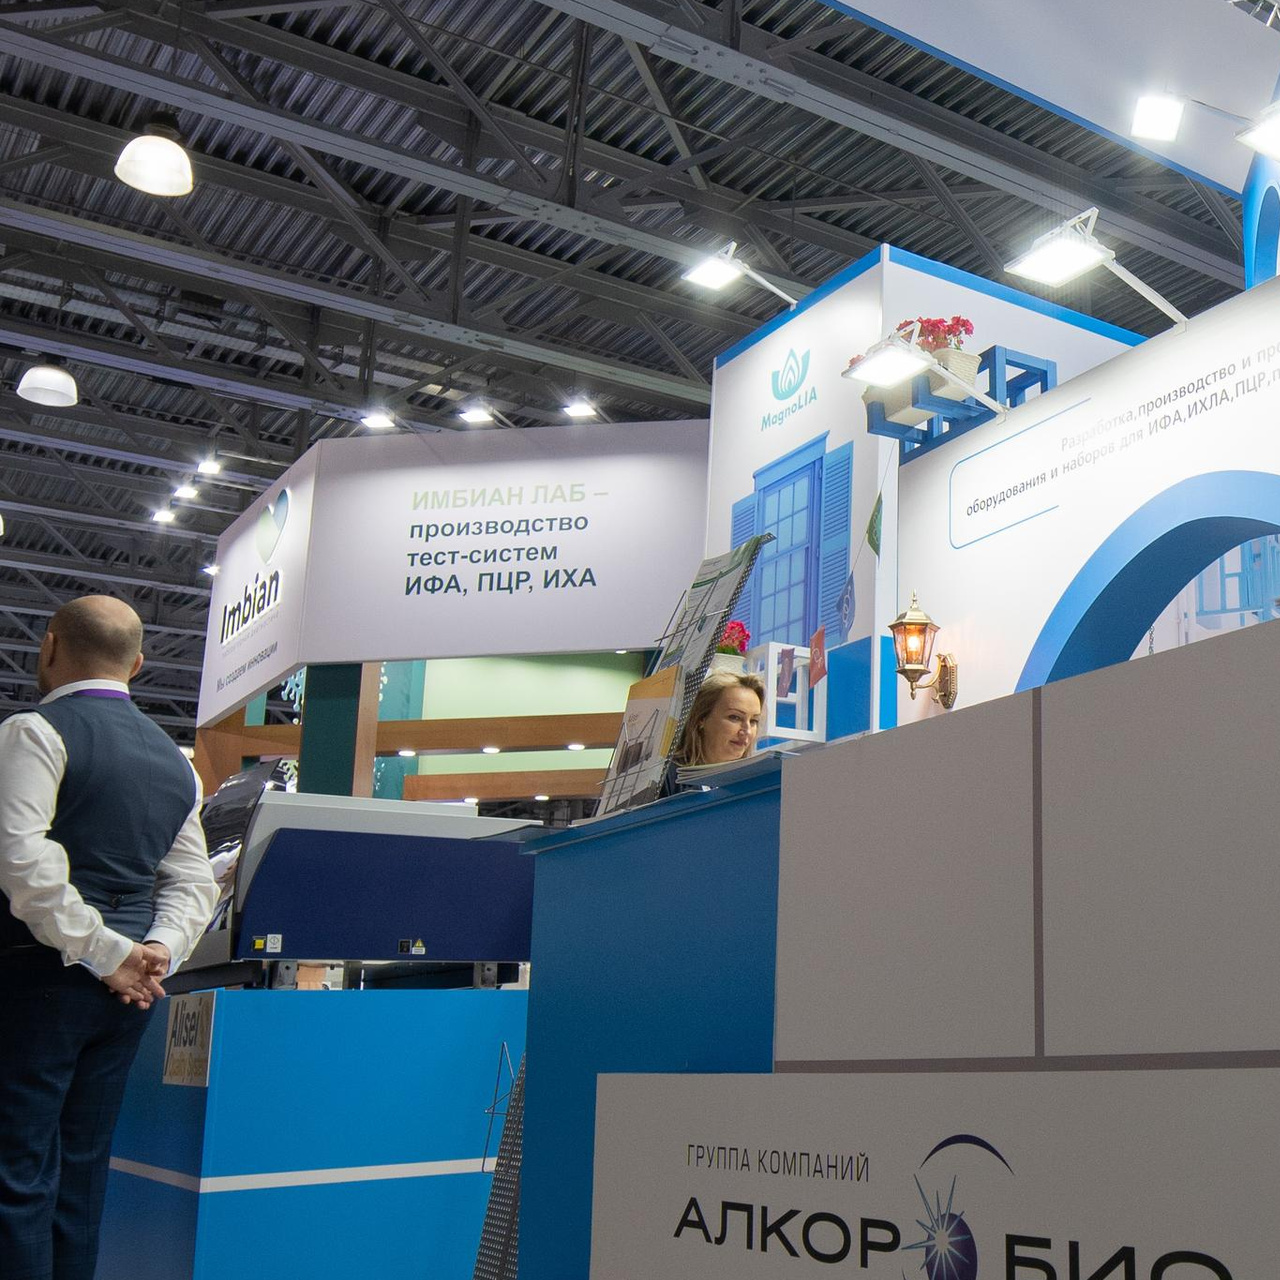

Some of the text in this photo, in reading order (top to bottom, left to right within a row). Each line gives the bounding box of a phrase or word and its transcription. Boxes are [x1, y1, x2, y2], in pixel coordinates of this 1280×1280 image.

[1241, 356, 1252, 370] и
[965, 472, 1047, 518] оборудования
[1050, 467, 1059, 480] и
[1061, 443, 1116, 476] наборов
[1118, 429, 1145, 453] для
[411, 485, 525, 511] ИМБИАН
[530, 482, 586, 505] ЛАБ
[409, 515, 589, 543] производство
[406, 545, 558, 567] тест-систем
[404, 567, 598, 597] ИФА, ПЦР, ИХА
[220, 569, 280, 644] Imbian
[686, 1143, 870, 1184] ГРУППА КОМПАНИЙ
[673, 1196, 902, 1270] АЛКОР
